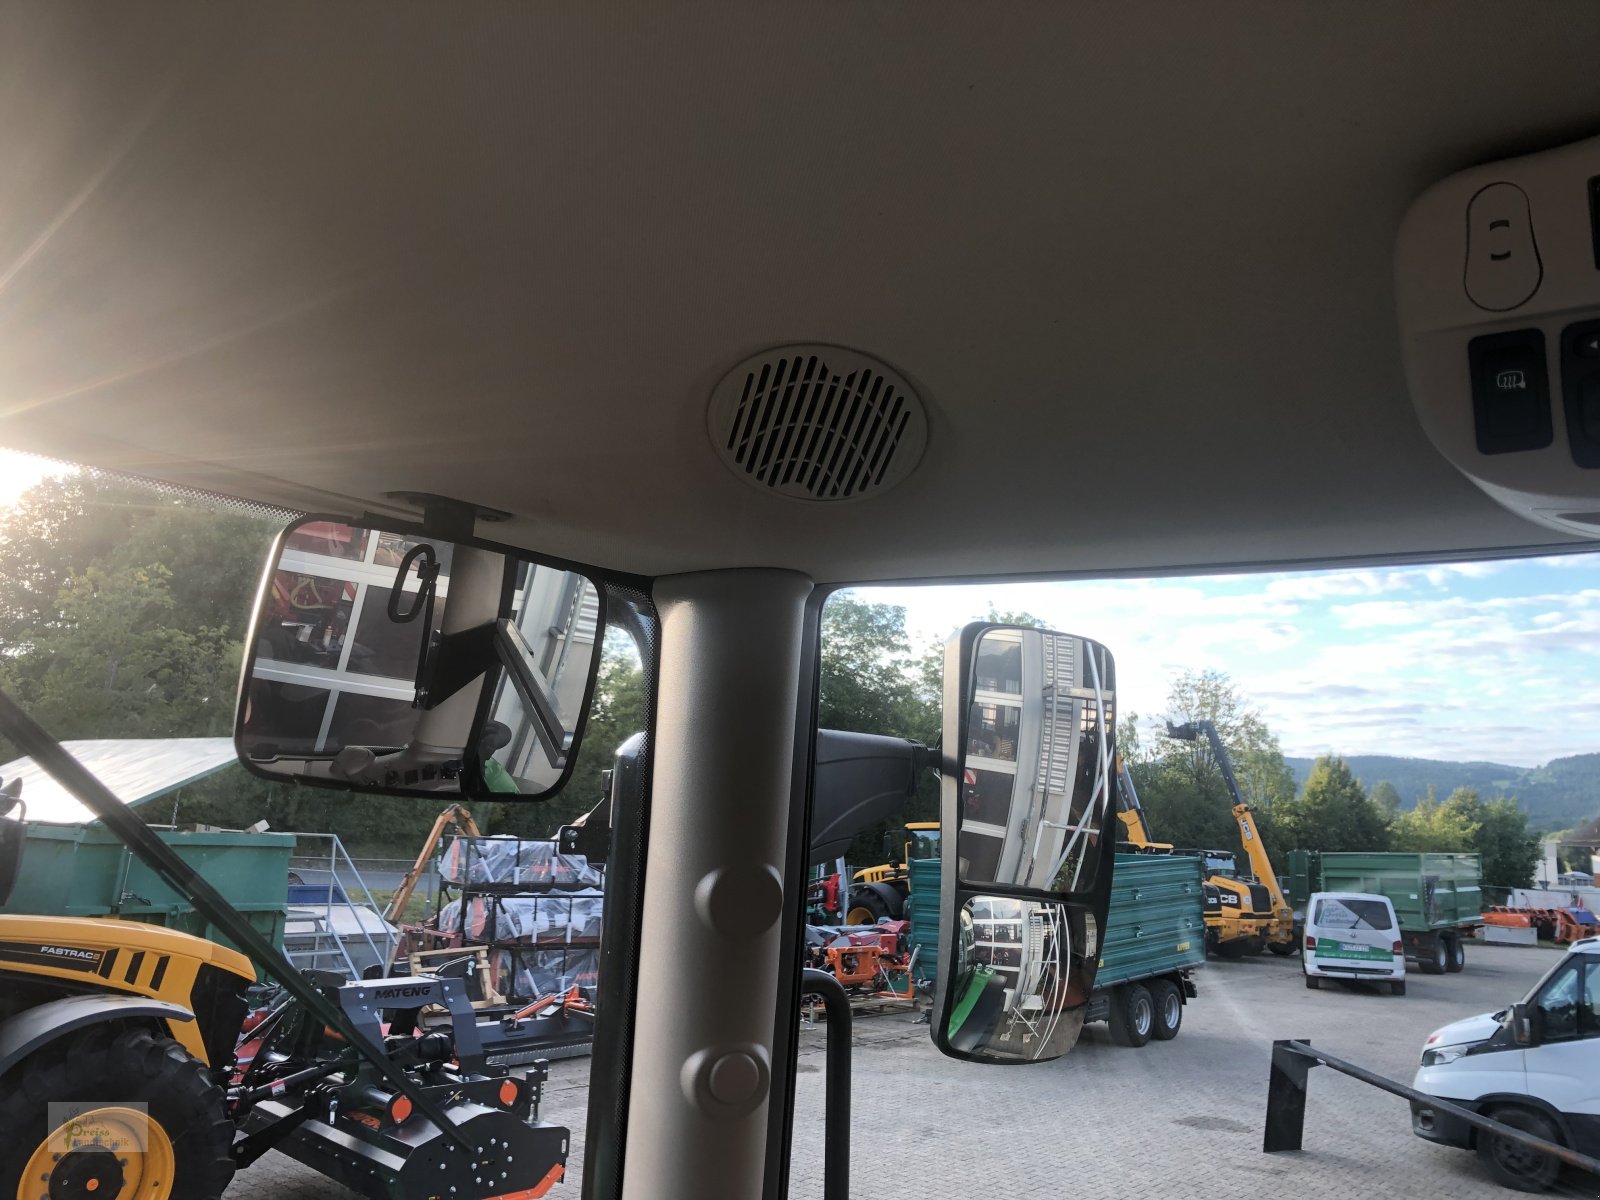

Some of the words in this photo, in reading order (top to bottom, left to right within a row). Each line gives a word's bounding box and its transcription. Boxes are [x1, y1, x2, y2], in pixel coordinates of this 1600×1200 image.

[1220, 894, 1238, 904] CB
[40, 946, 94, 960] FASTRAC
[374, 986, 431, 1000] MATENG
